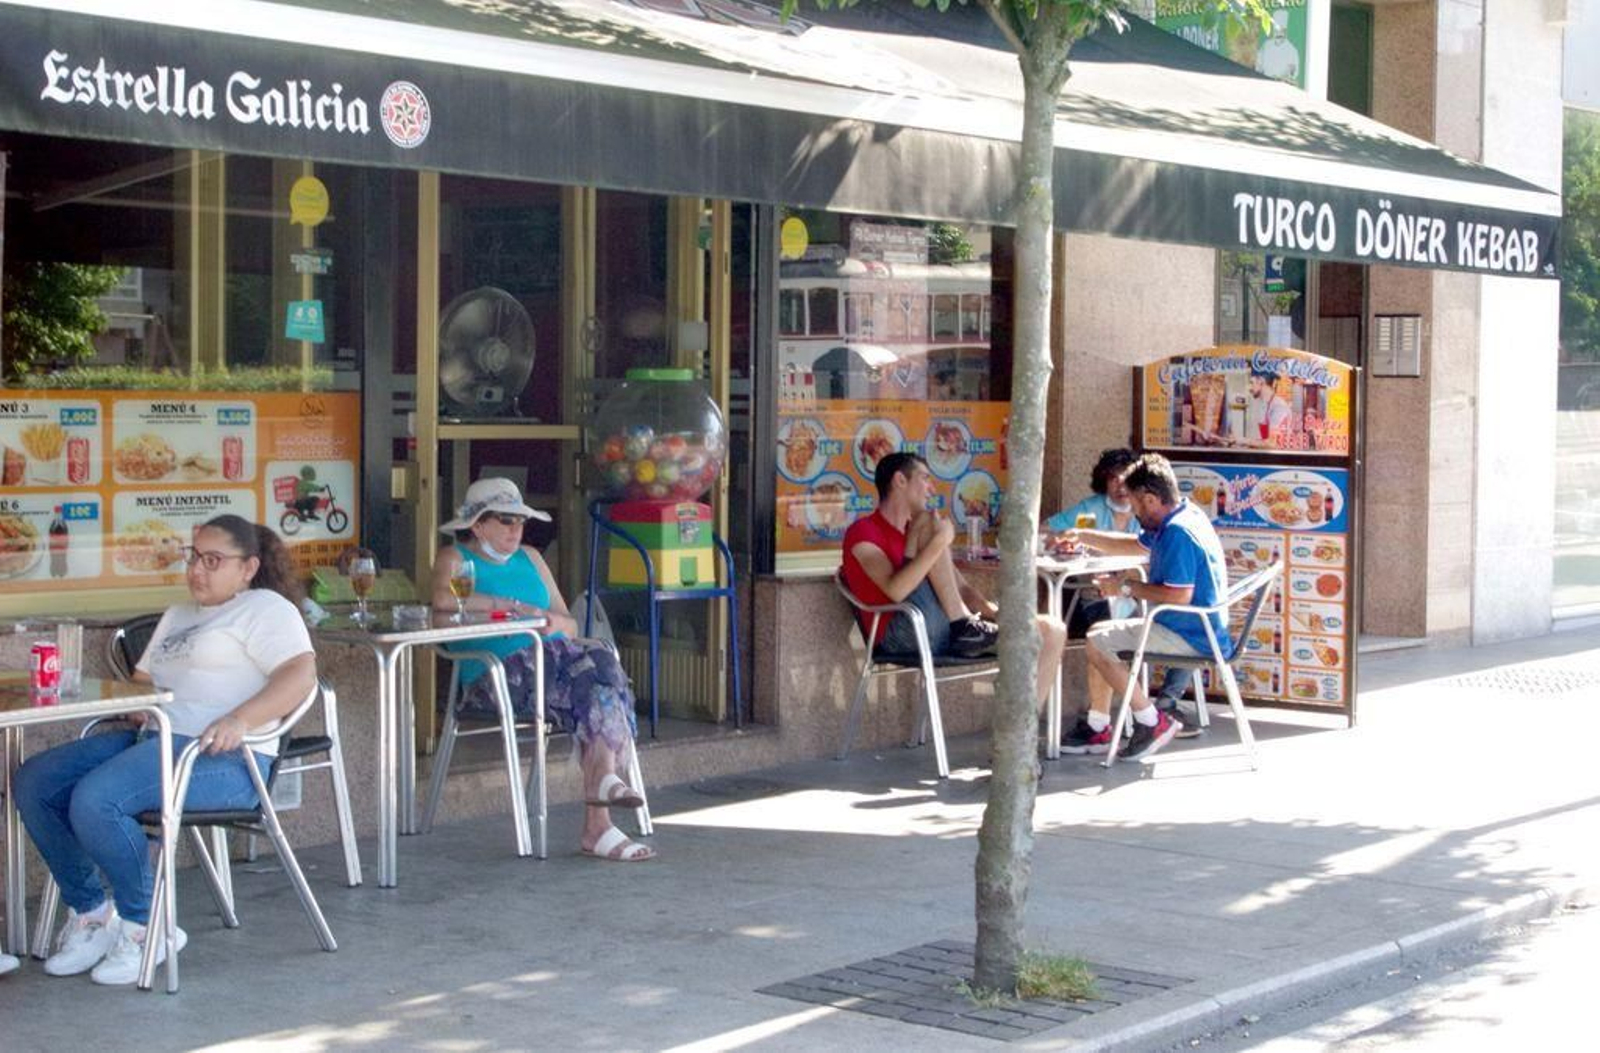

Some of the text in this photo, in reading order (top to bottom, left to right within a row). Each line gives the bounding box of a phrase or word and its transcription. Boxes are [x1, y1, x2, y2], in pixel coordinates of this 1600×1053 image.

[40, 49, 216, 120] Estrella
[225, 70, 371, 135] Galicia
[1233, 192, 1540, 273] TURCO DÖNER KEBAB
[150, 401, 196, 413] MENÚ 4
[136, 494, 231, 507] MENÚ INFANTIL
